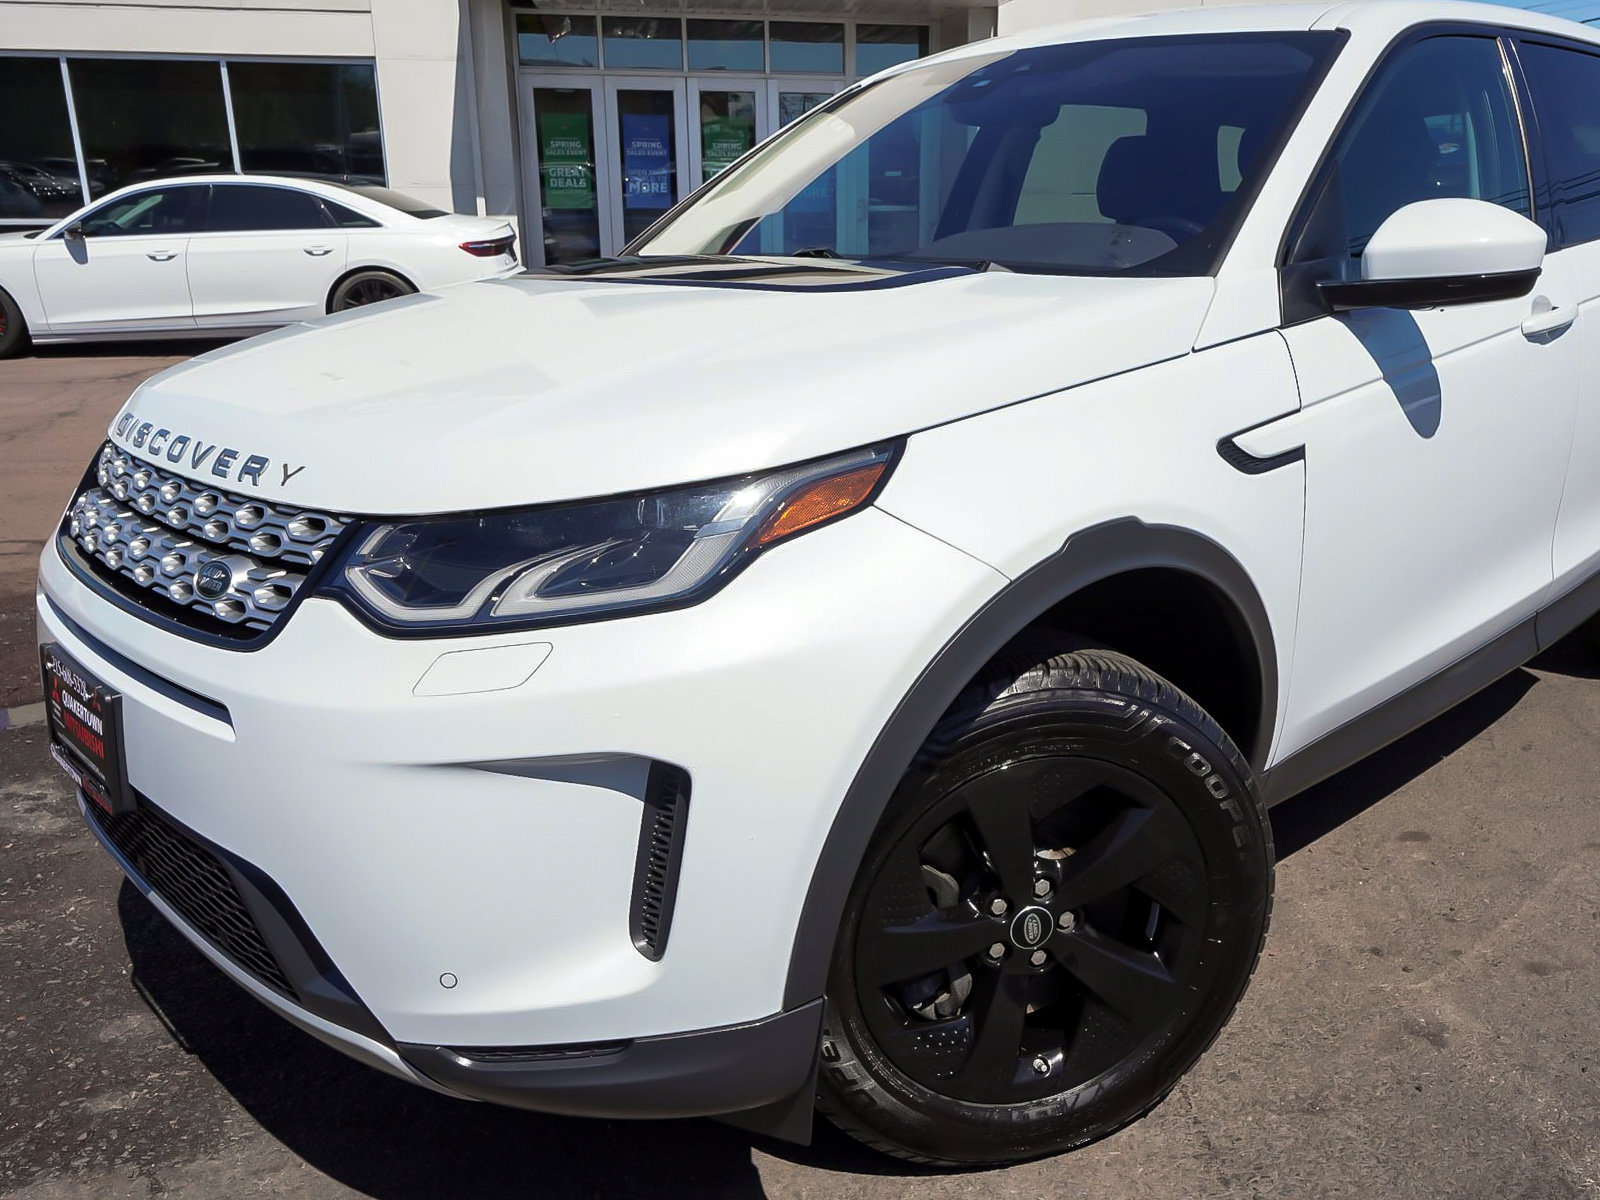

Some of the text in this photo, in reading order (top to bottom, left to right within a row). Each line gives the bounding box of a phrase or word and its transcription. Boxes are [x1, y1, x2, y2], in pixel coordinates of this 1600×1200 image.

[549, 140, 582, 148] SPRING
[631, 141, 662, 149] SPRING
[549, 168, 586, 177] GREAT
[550, 178, 587, 188] DEALS
[629, 182, 668, 193] MORE
[115, 412, 306, 487] DISCOVERY
[61, 689, 103, 736] QUAKERTOWN
